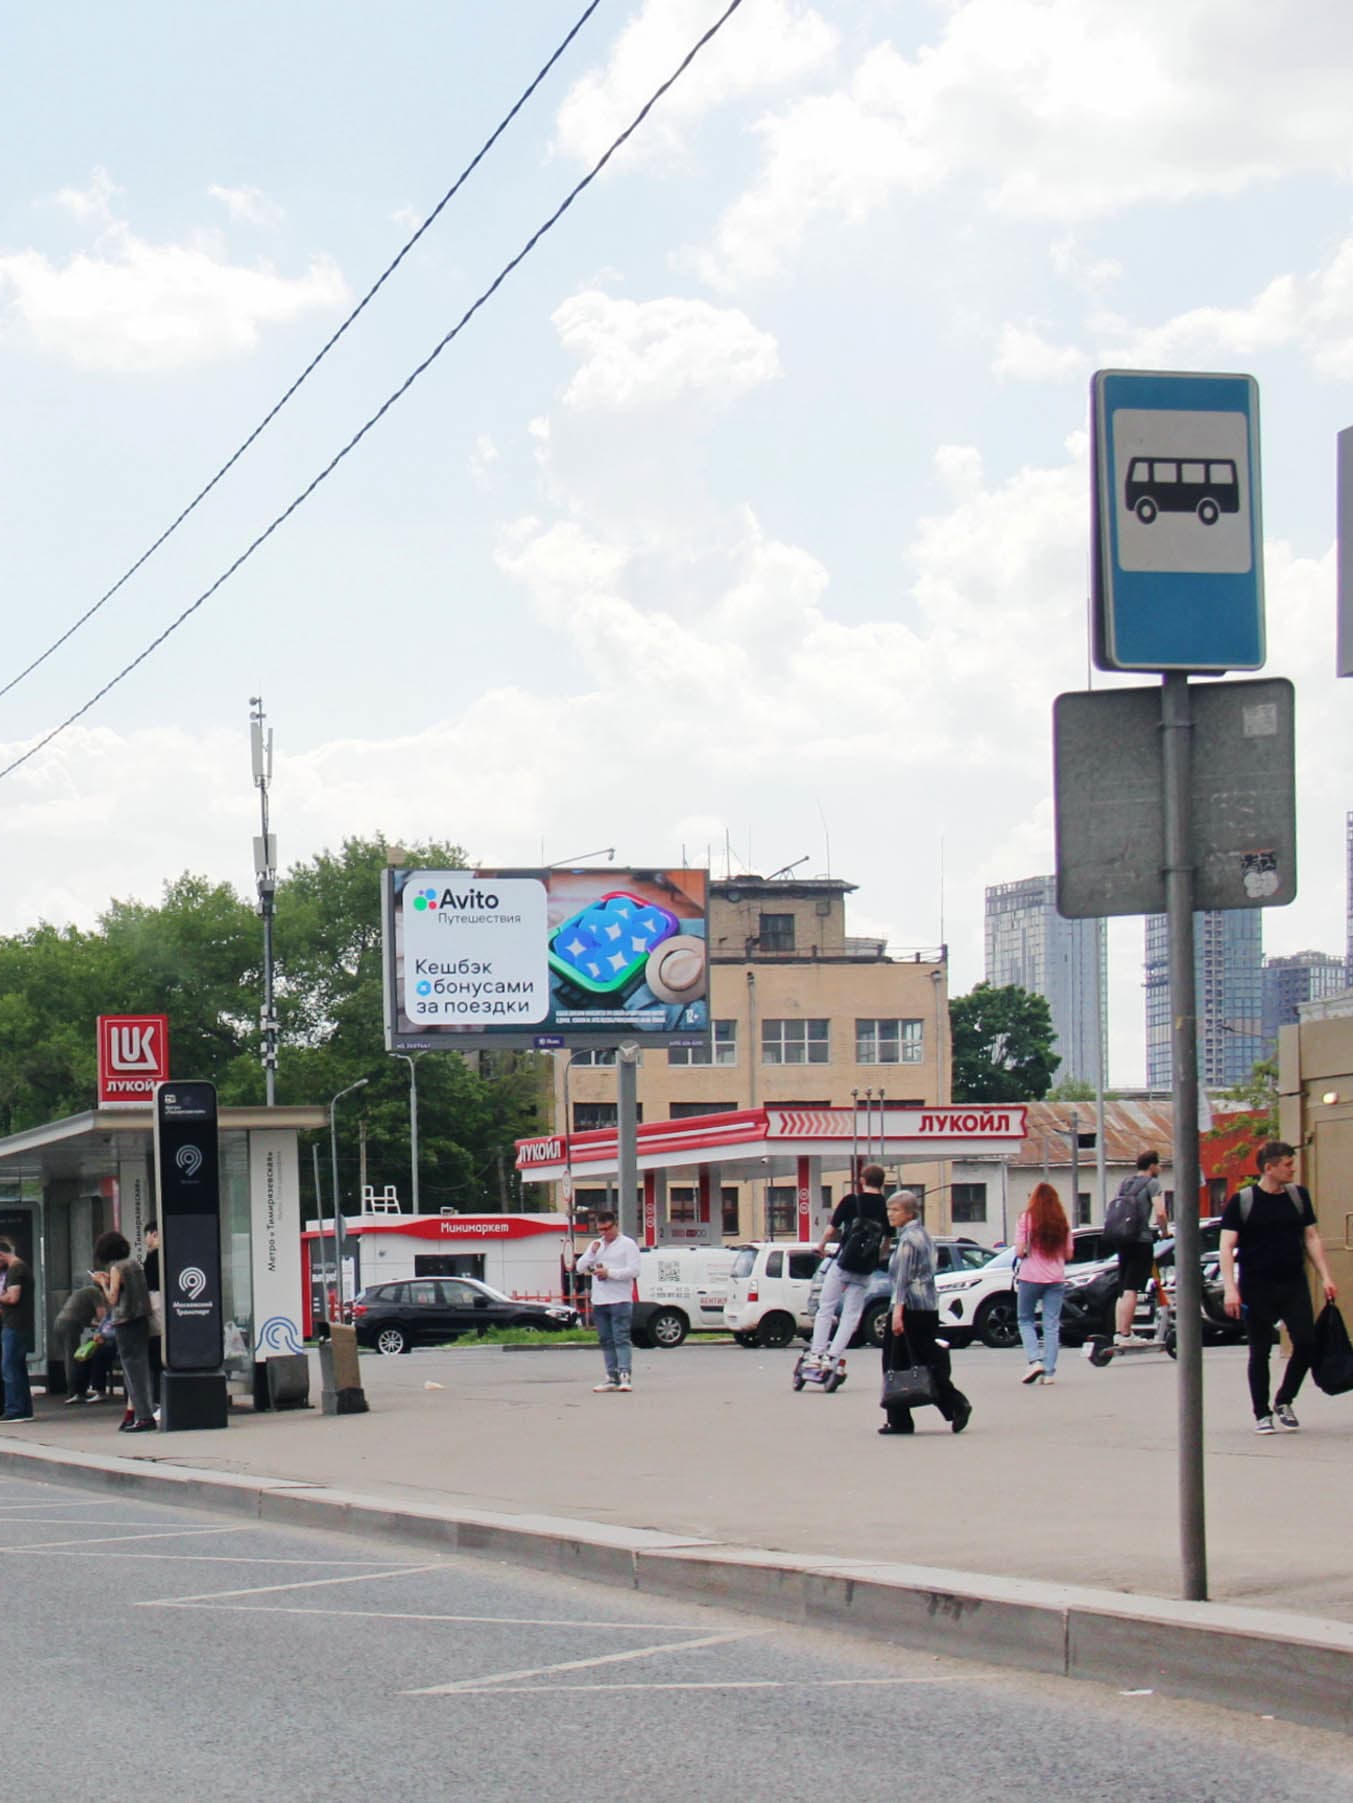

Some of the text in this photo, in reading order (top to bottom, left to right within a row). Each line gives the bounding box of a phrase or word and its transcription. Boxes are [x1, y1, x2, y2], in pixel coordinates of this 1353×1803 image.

[439, 888, 499, 909] Avito
[438, 912, 521, 925] Путешествия
[415, 959, 492, 975] Кешбэк
[433, 979, 534, 998] бонусами
[416, 1001, 529, 1015] за поездки
[106, 1079, 161, 1092] ЛУКОЙ
[918, 1110, 1010, 1132] ЛУКОЙЛ
[518, 1136, 561, 1162] ЛУКОЙЛ
[440, 1221, 509, 1235] Минимаркет
[267, 1239, 276, 1272] Метро
